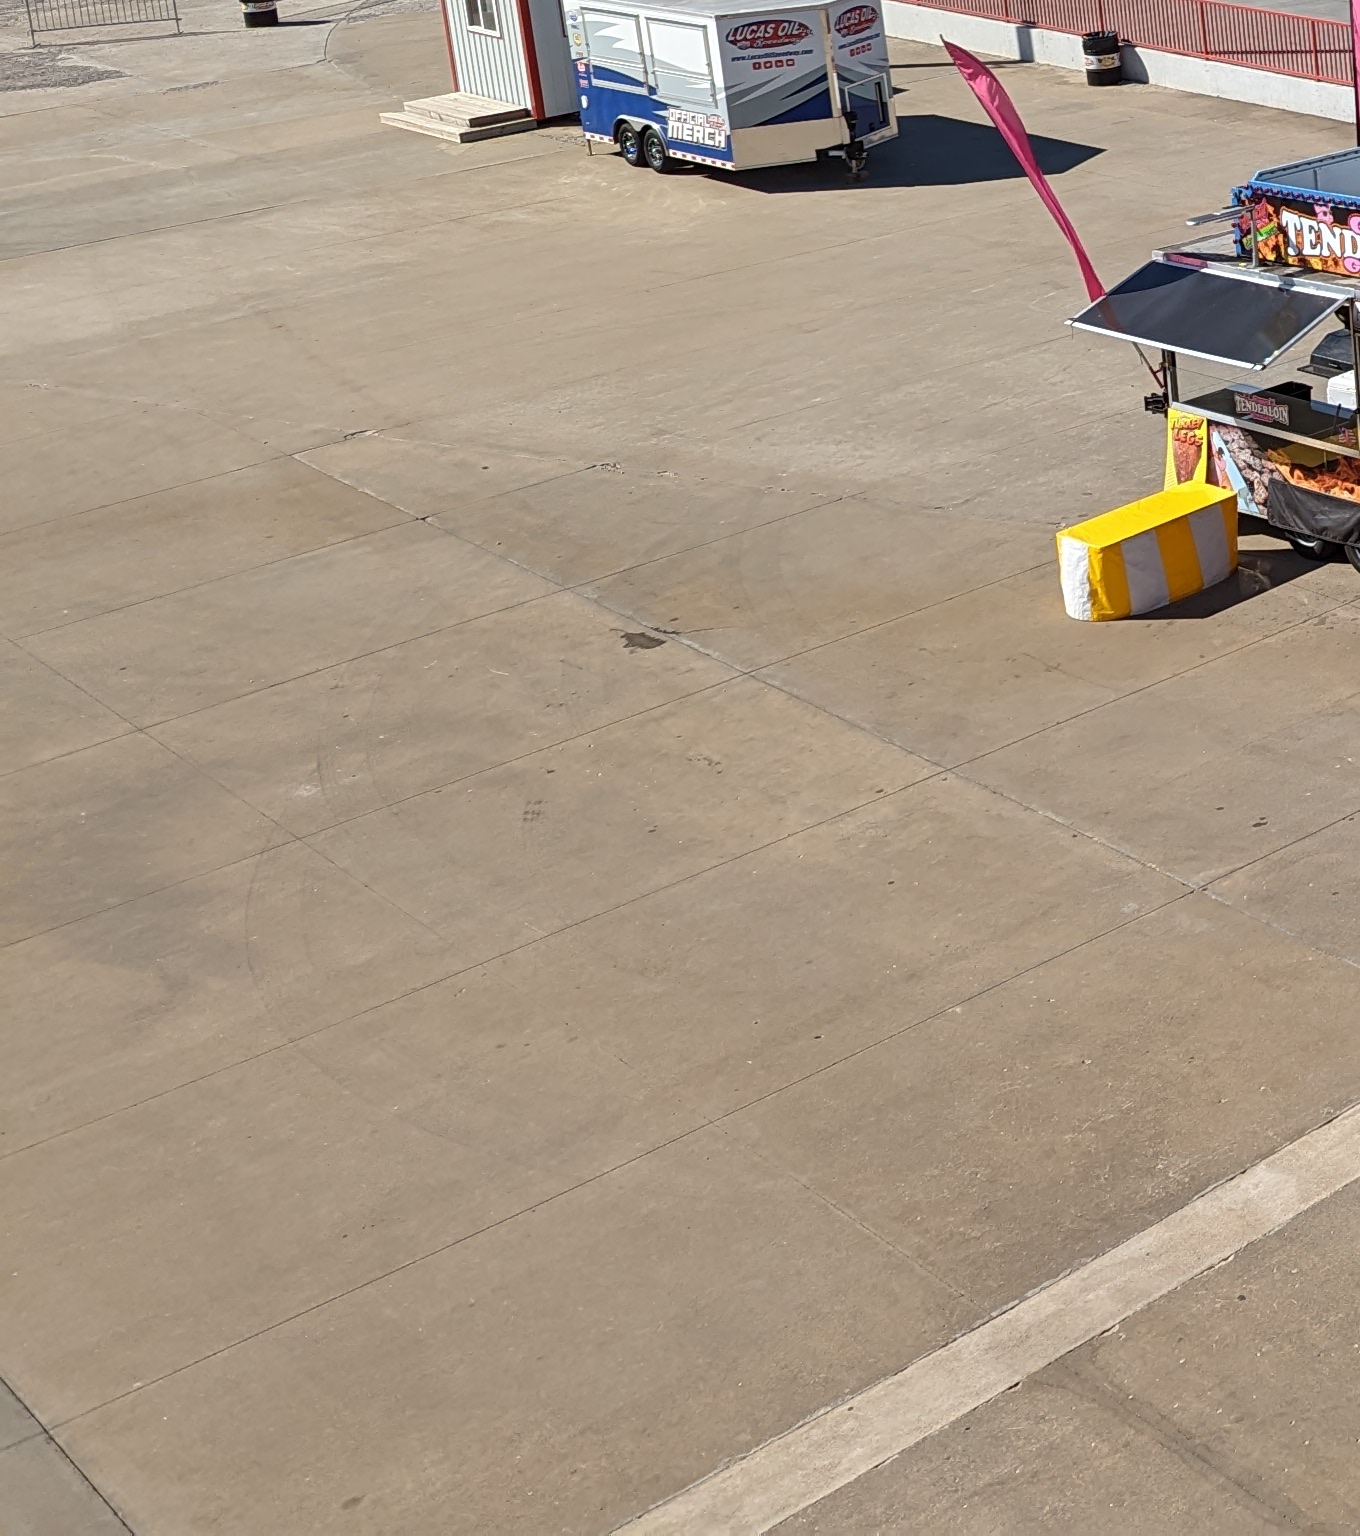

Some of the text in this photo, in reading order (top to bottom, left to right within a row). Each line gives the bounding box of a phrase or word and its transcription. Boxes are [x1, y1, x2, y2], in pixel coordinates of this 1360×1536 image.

[728, 22, 801, 41] LUCAS OIL
[669, 109, 710, 127] OFFICIAL
[668, 121, 725, 148] MERCH
[1234, 393, 1289, 426] TENDERLOIN
[1170, 417, 1204, 430] TURKEY
[1173, 429, 1203, 447] LEGS
